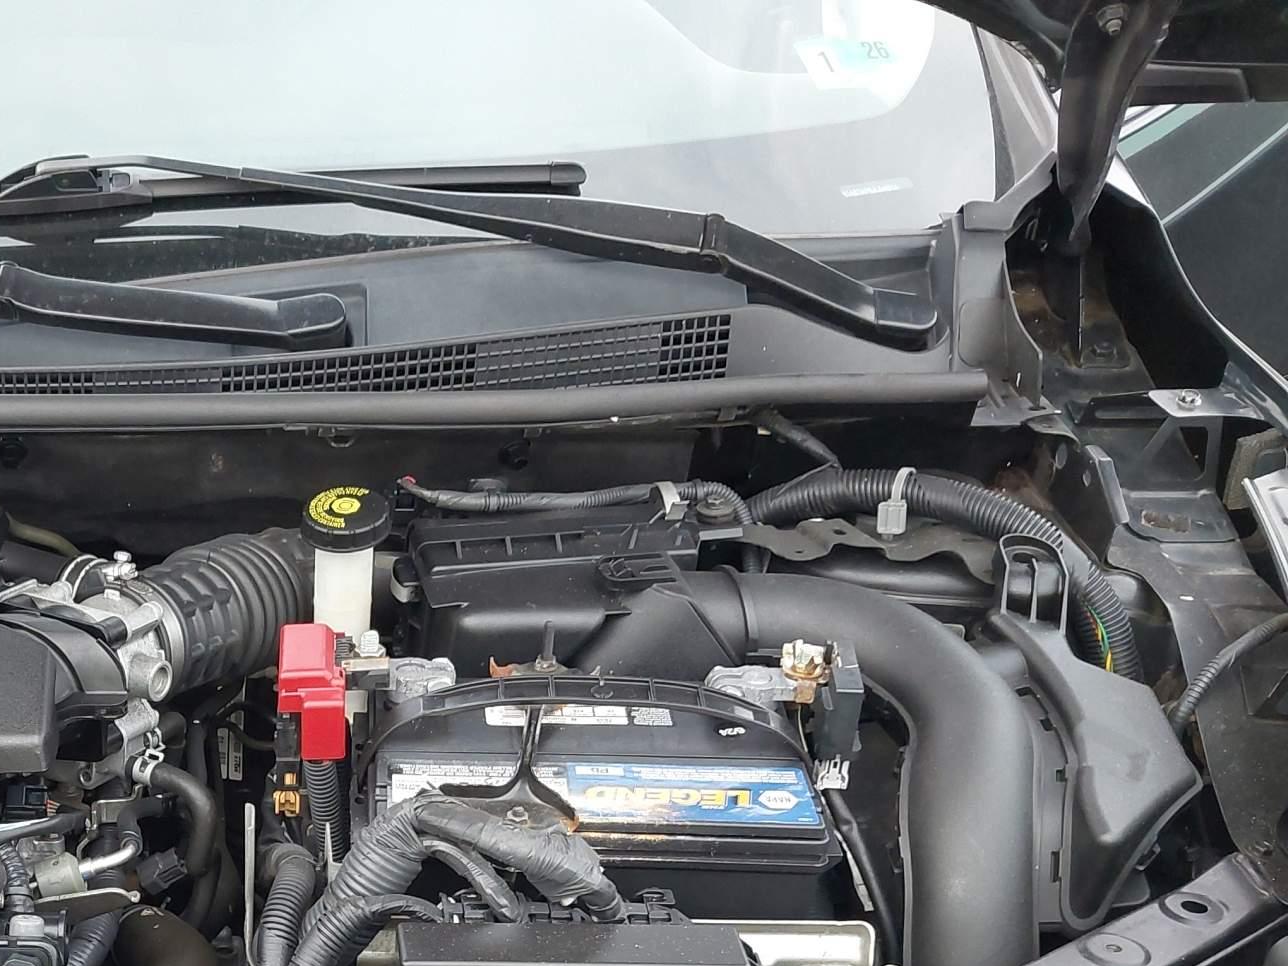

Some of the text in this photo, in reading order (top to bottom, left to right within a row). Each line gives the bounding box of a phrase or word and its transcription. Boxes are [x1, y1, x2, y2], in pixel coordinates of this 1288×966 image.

[817, 41, 890, 72] 1 26
[583, 785, 752, 808] LEGEND
